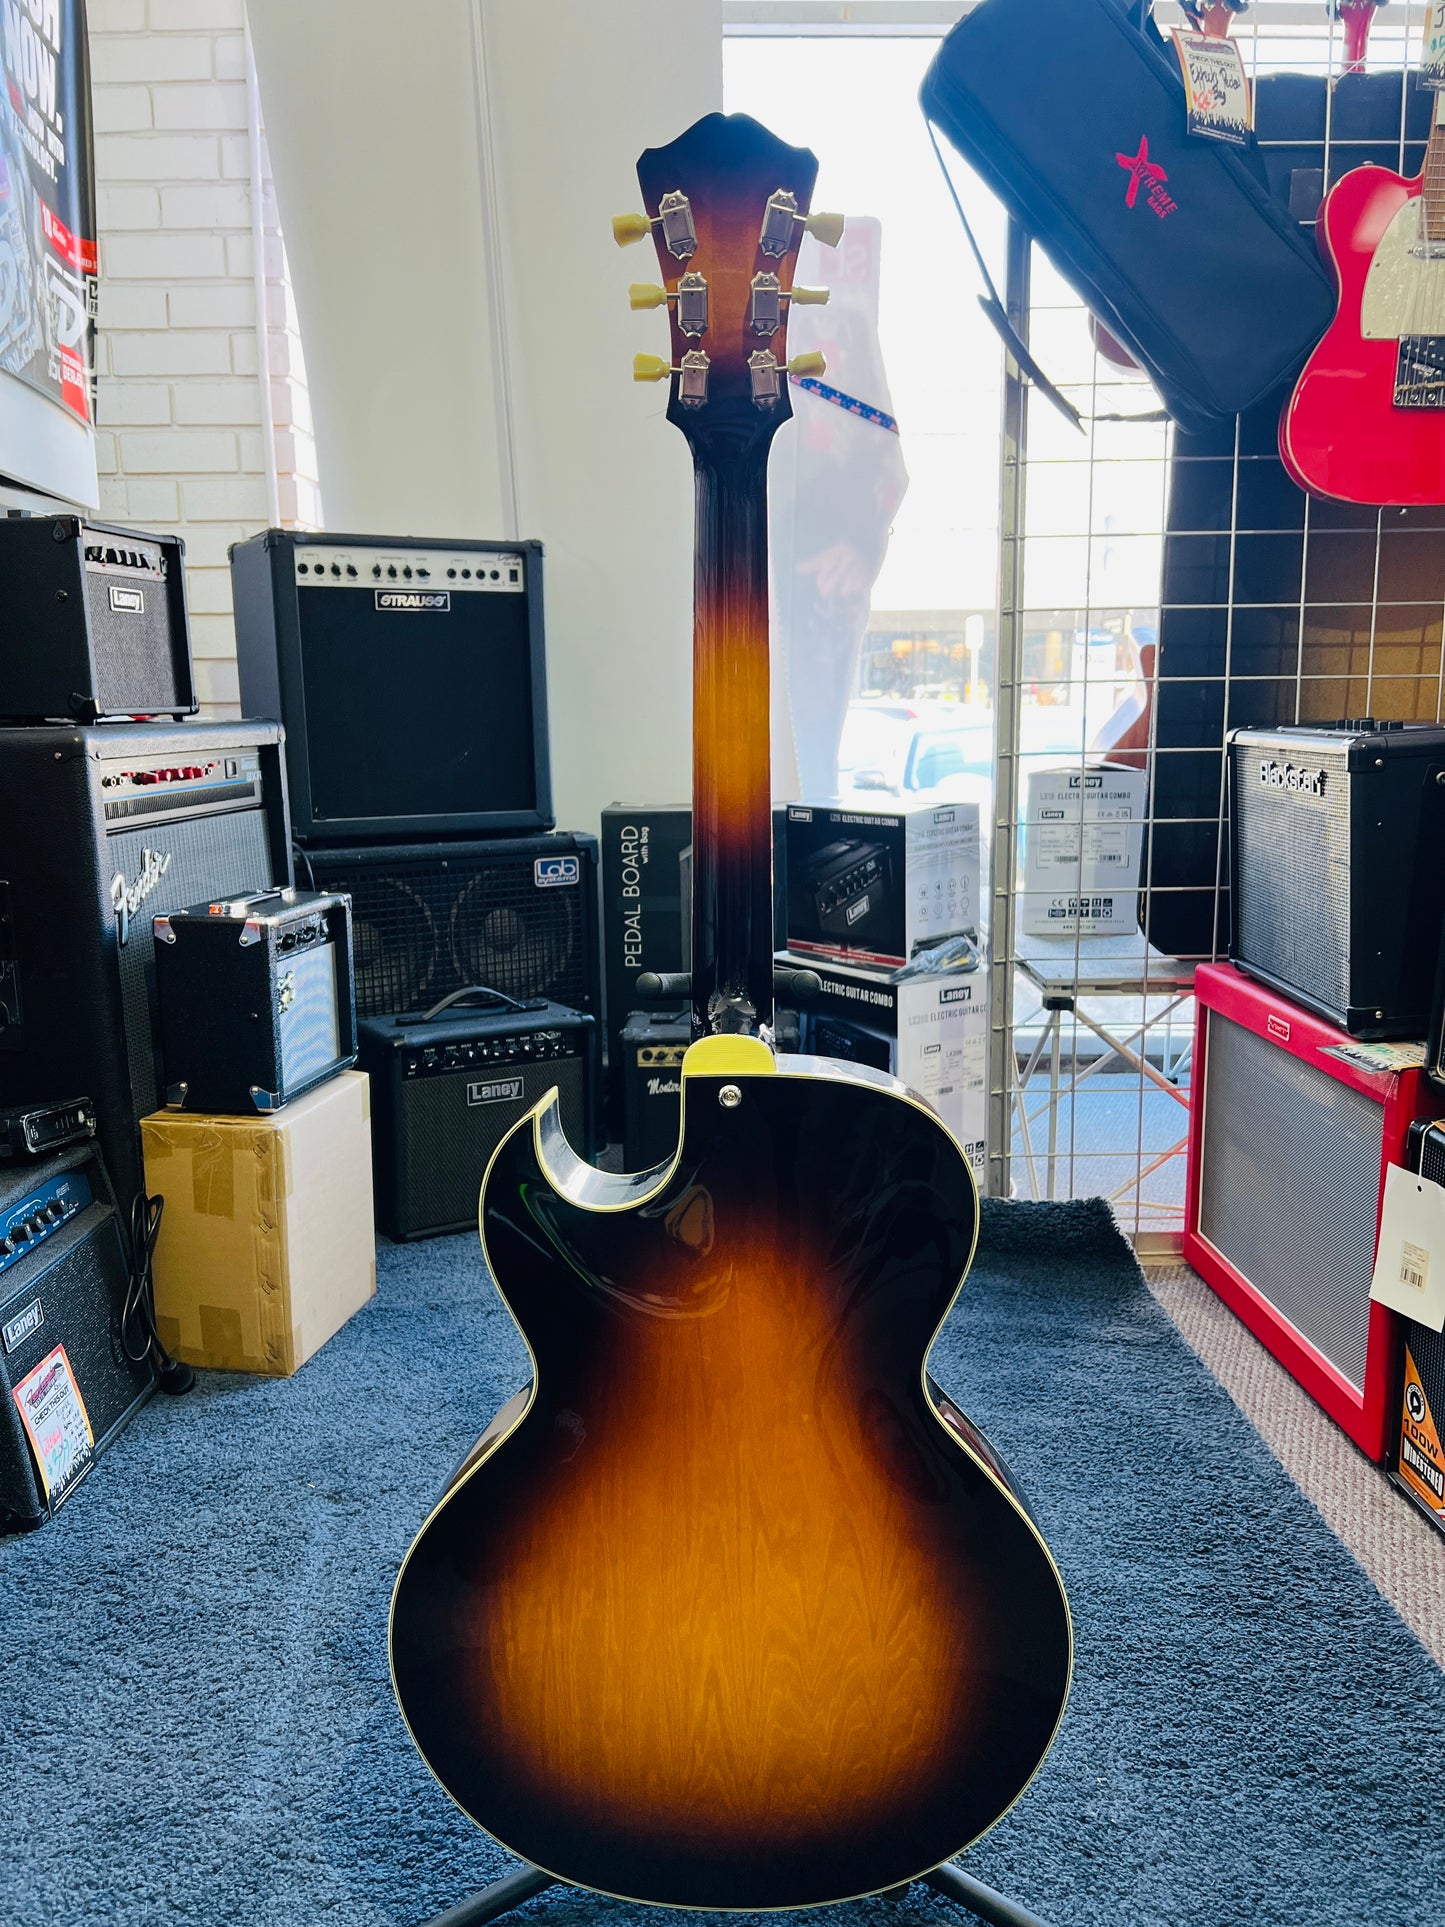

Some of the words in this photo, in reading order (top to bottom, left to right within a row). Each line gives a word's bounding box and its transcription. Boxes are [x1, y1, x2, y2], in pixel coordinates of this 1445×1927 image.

[113, 590, 141, 610] Laney
[380, 595, 446, 607] STRAUSS
[1260, 761, 1325, 796] Blackstar
[1087, 792, 1108, 800] GUITAR
[881, 818, 899, 827] COMBO
[640, 826, 650, 845] Bag
[620, 825, 641, 898] BOARD
[642, 845, 650, 865] with
[537, 860, 576, 877] Lab
[110, 848, 171, 945] Fender
[623, 903, 642, 967] PEDAL
[820, 980, 845, 996] LECTRIC
[845, 985, 869, 1001] GUITAR
[869, 992, 893, 1008] COMBO
[941, 986, 970, 1002] Laney
[930, 1008, 958, 1022] ELECTRIC
[958, 1005, 979, 1017] GUITAR
[472, 1080, 520, 1101] Laney
[7, 1305, 39, 1342] Laney
[34, 1405, 51, 1426] CHECK
[1403, 1418, 1439, 1459] 100W
